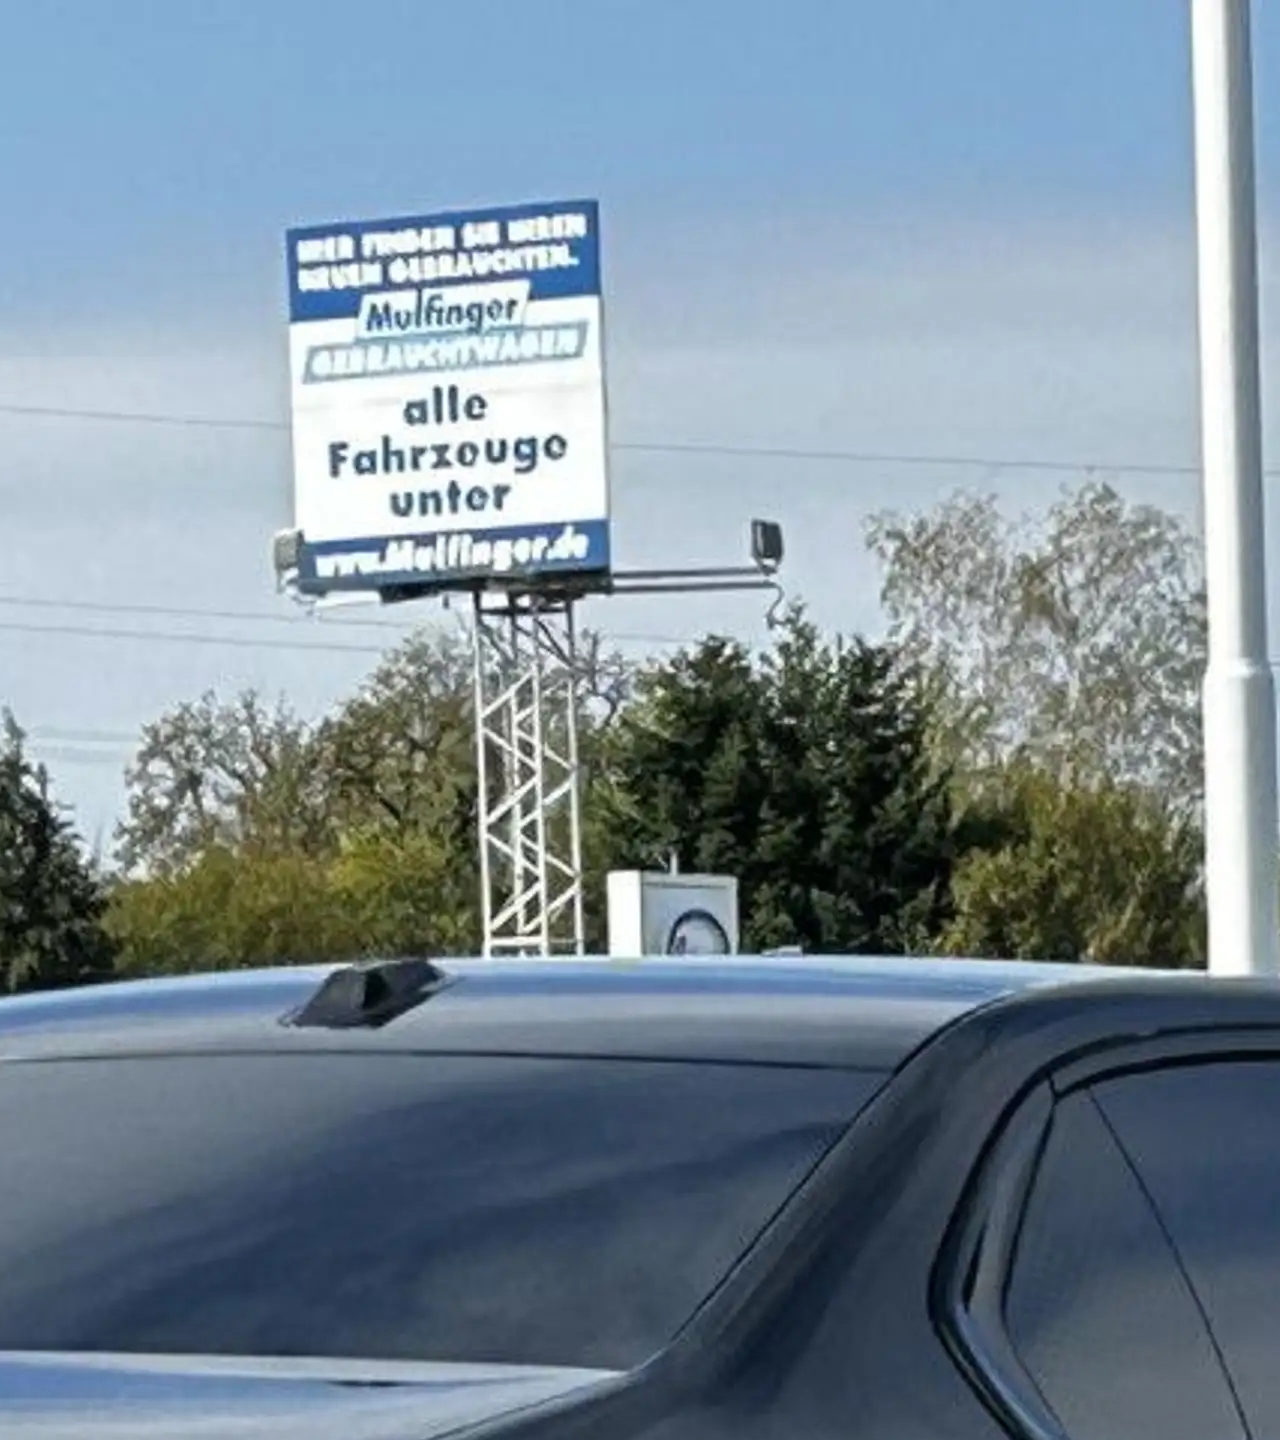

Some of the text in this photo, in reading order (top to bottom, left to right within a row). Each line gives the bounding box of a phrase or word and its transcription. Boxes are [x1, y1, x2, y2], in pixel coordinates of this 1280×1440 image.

[366, 291, 518, 333] Mulfinger
[403, 385, 488, 426] alle
[328, 434, 568, 477] Fahrzeuge
[390, 480, 511, 517] unter
